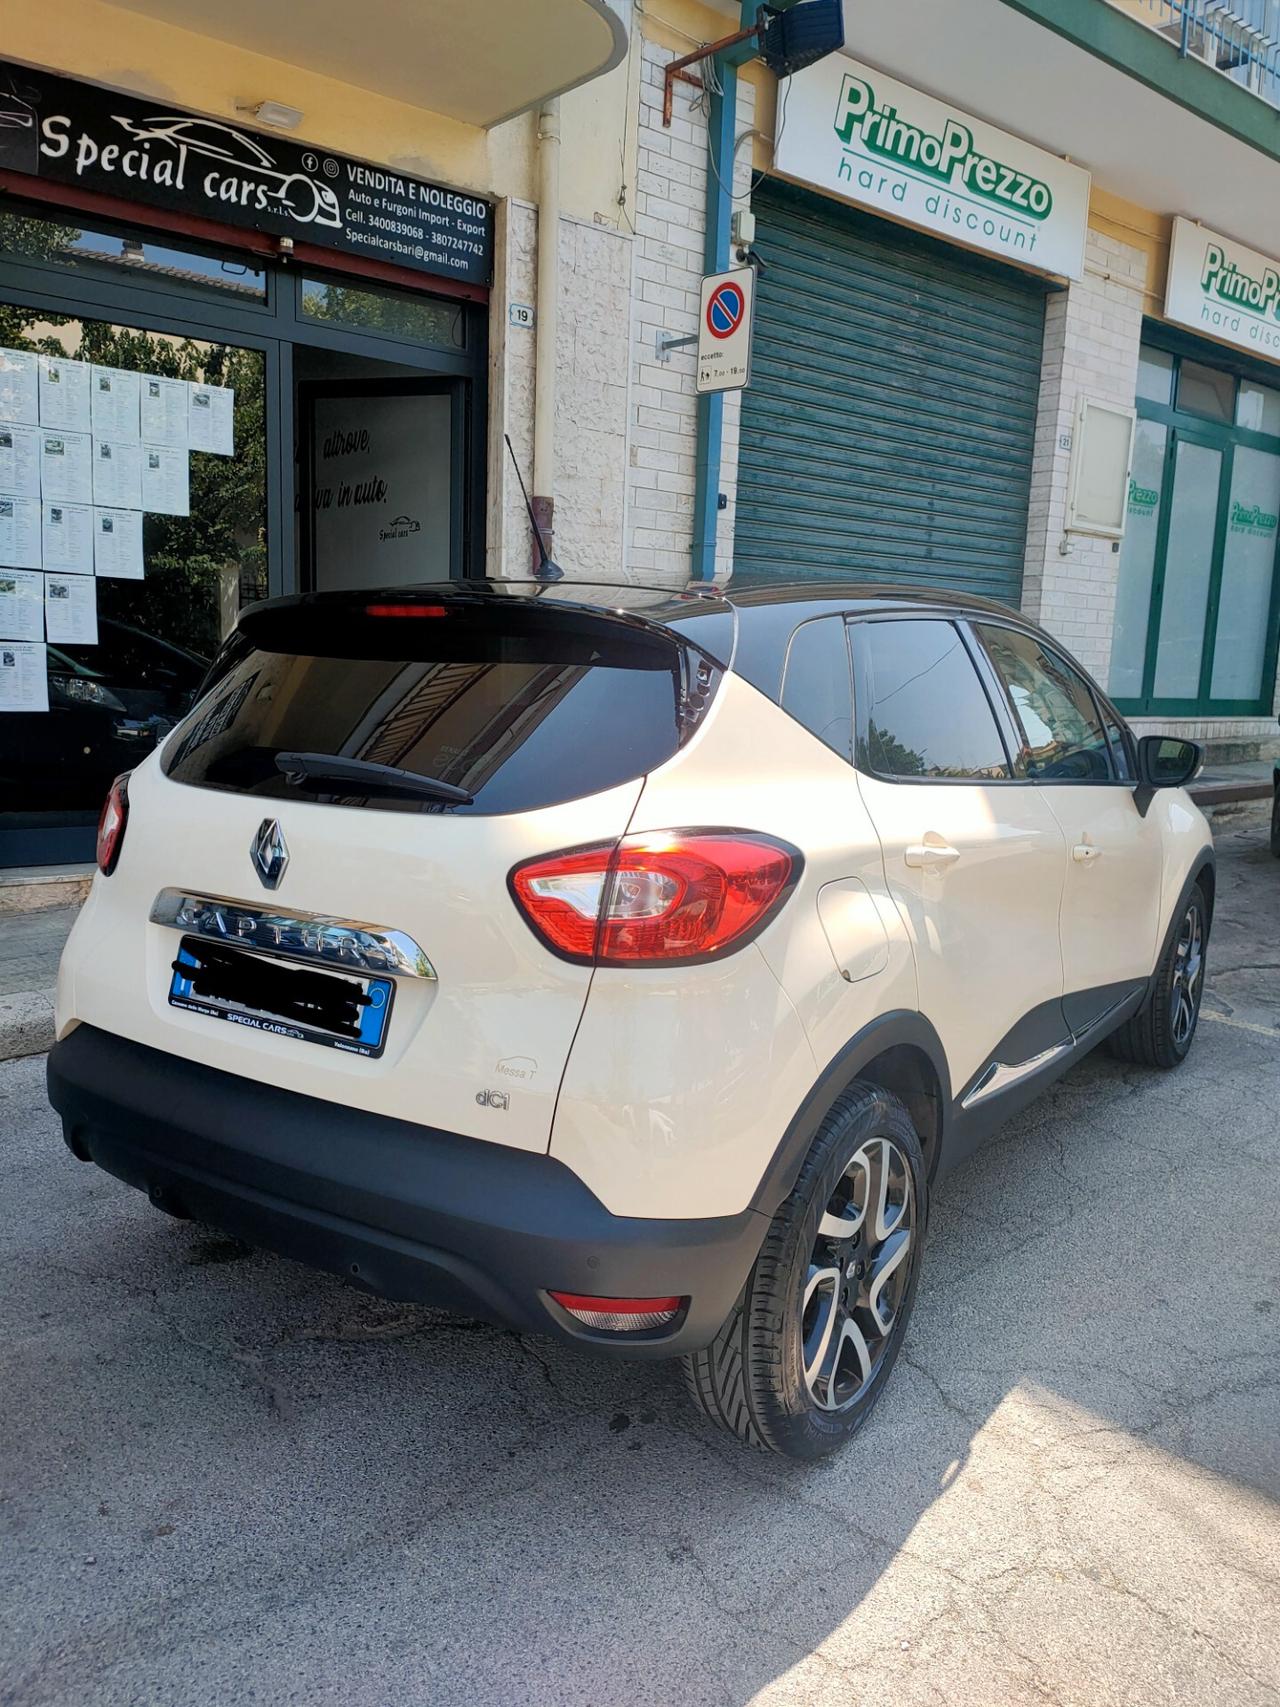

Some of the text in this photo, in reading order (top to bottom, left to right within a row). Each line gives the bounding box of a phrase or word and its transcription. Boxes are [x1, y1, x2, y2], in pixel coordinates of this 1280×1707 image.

[41, 116, 270, 211] Special cars
[834, 73, 1053, 221] PrimoPrezzo
[347, 164, 486, 219] VENDITA E NOLEGGIO
[348, 189, 372, 206] Auto
[373, 198, 380, 207] e
[382, 198, 417, 218] Furgoni
[418, 208, 450, 227] Import
[457, 219, 486, 237] Export
[837, 157, 1037, 252] hard discount
[345, 208, 366, 224] Cell.
[368, 215, 424, 240] 3400839068
[431, 231, 484, 256] 3807247742
[345, 227, 469, 270] Specialcarsbari@gmail.com
[517, 309, 528, 321] 19
[1201, 304, 1240, 332] hard
[701, 352, 724, 360] eccetto:
[324, 430, 370, 459] altrove,
[337, 481, 351, 508] in
[353, 475, 388, 505] auto.
[178, 908, 369, 967] CAPTUR
[227, 1013, 288, 1034] SPECIAL CARS
